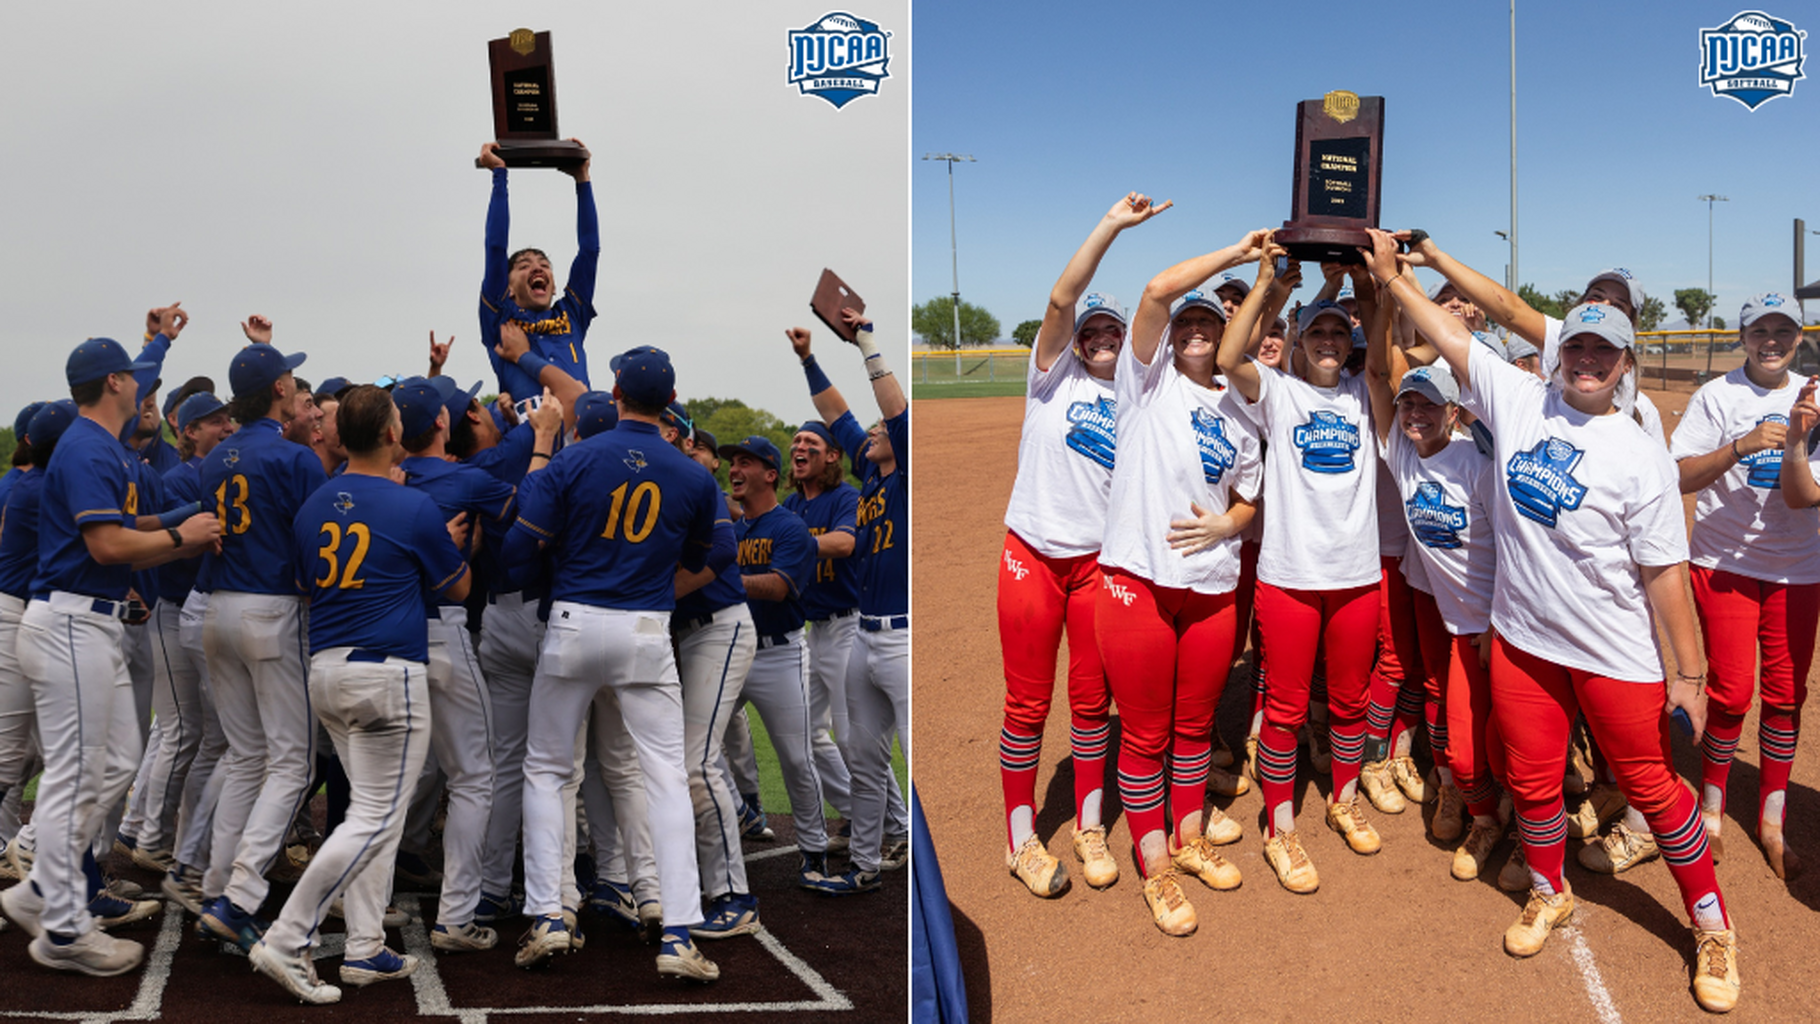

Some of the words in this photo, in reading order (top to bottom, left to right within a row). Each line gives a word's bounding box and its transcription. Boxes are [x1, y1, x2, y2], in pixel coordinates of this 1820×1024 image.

[1069, 405, 1116, 434] CHAMP
[1296, 428, 1360, 447] CHAMPIONS
[1508, 458, 1581, 506] CHAMPIONS
[215, 474, 251, 536] 13
[601, 481, 662, 544] 10
[316, 522, 371, 589] 32
[873, 519, 895, 554] 12
[816, 558, 836, 583] 14
